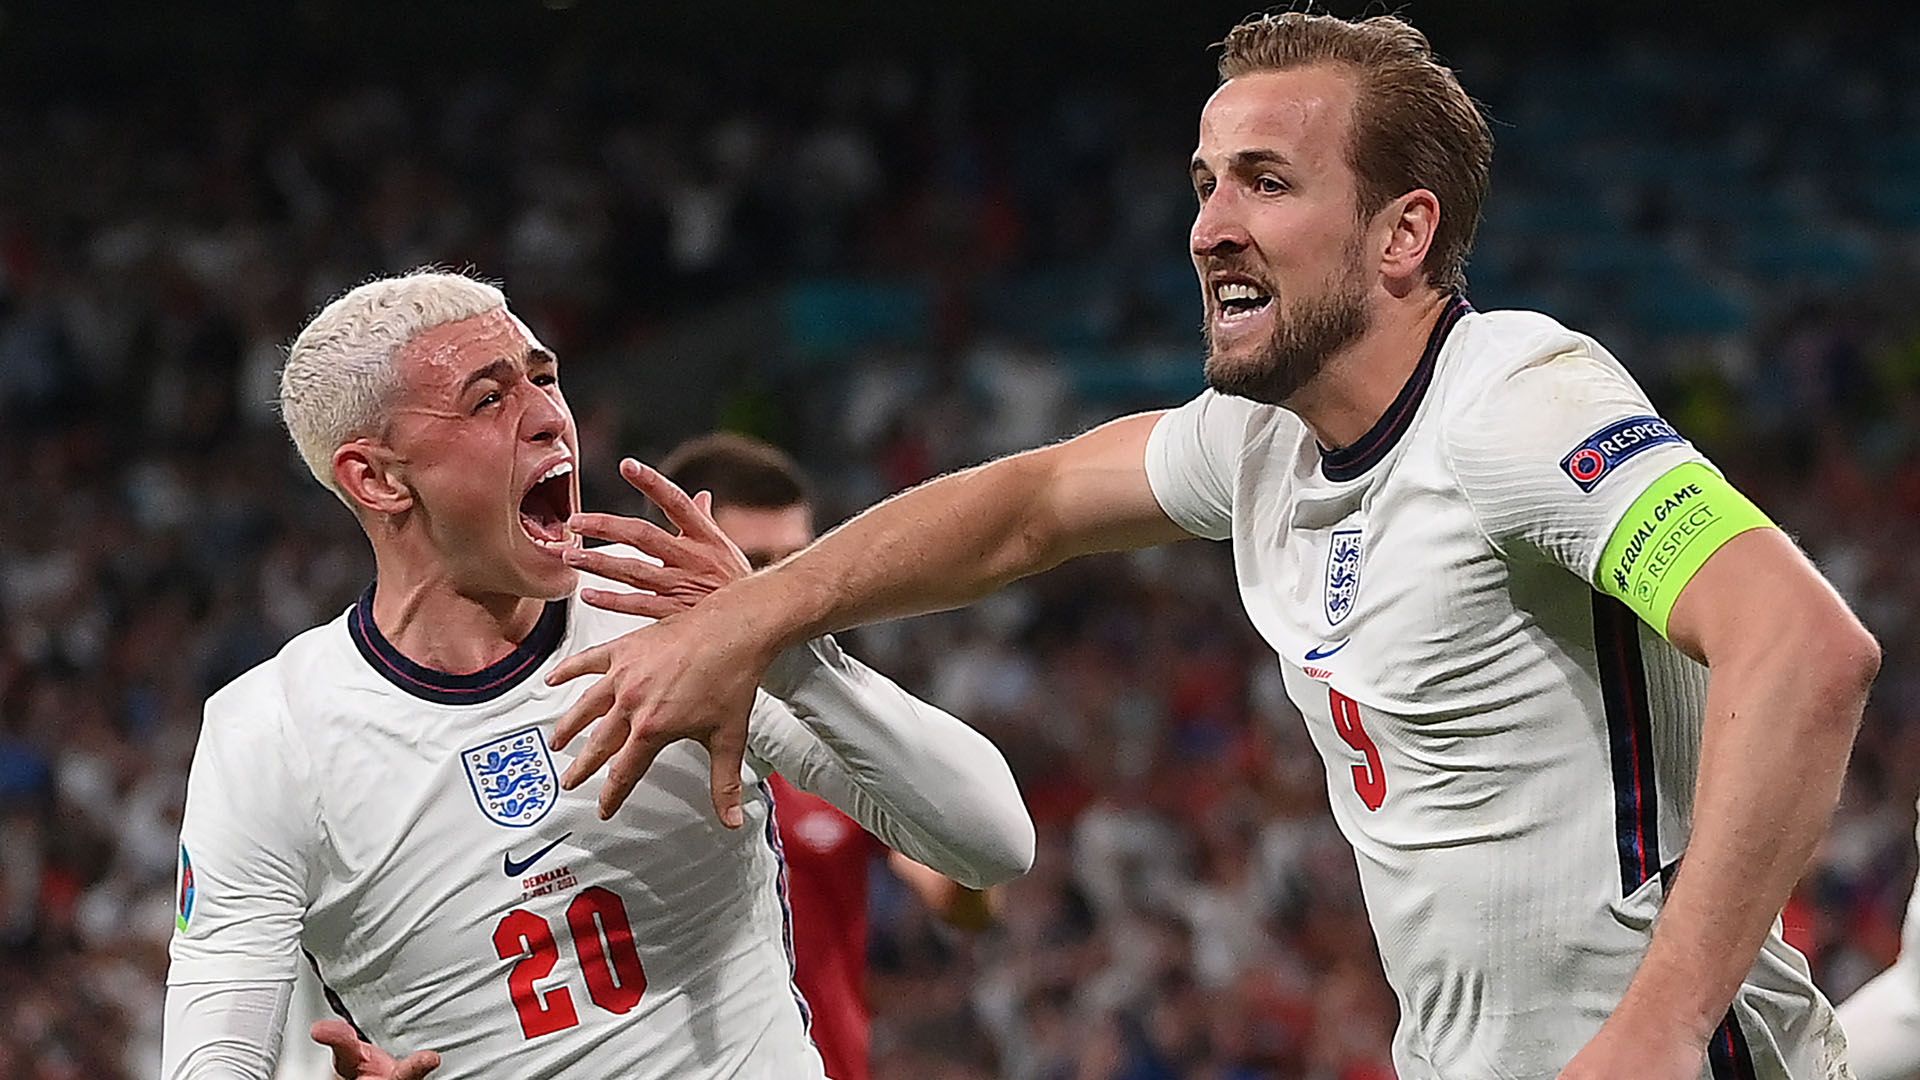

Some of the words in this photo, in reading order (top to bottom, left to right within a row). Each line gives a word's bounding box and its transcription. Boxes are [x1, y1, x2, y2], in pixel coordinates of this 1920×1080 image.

[1613, 520, 1657, 594] #EQUAL
[1654, 483, 1703, 522] GAME
[1647, 505, 1714, 578] RESPECT
[1329, 686, 1387, 812] 9
[522, 866, 570, 889] DENMARK
[492, 885, 648, 1040] 20
